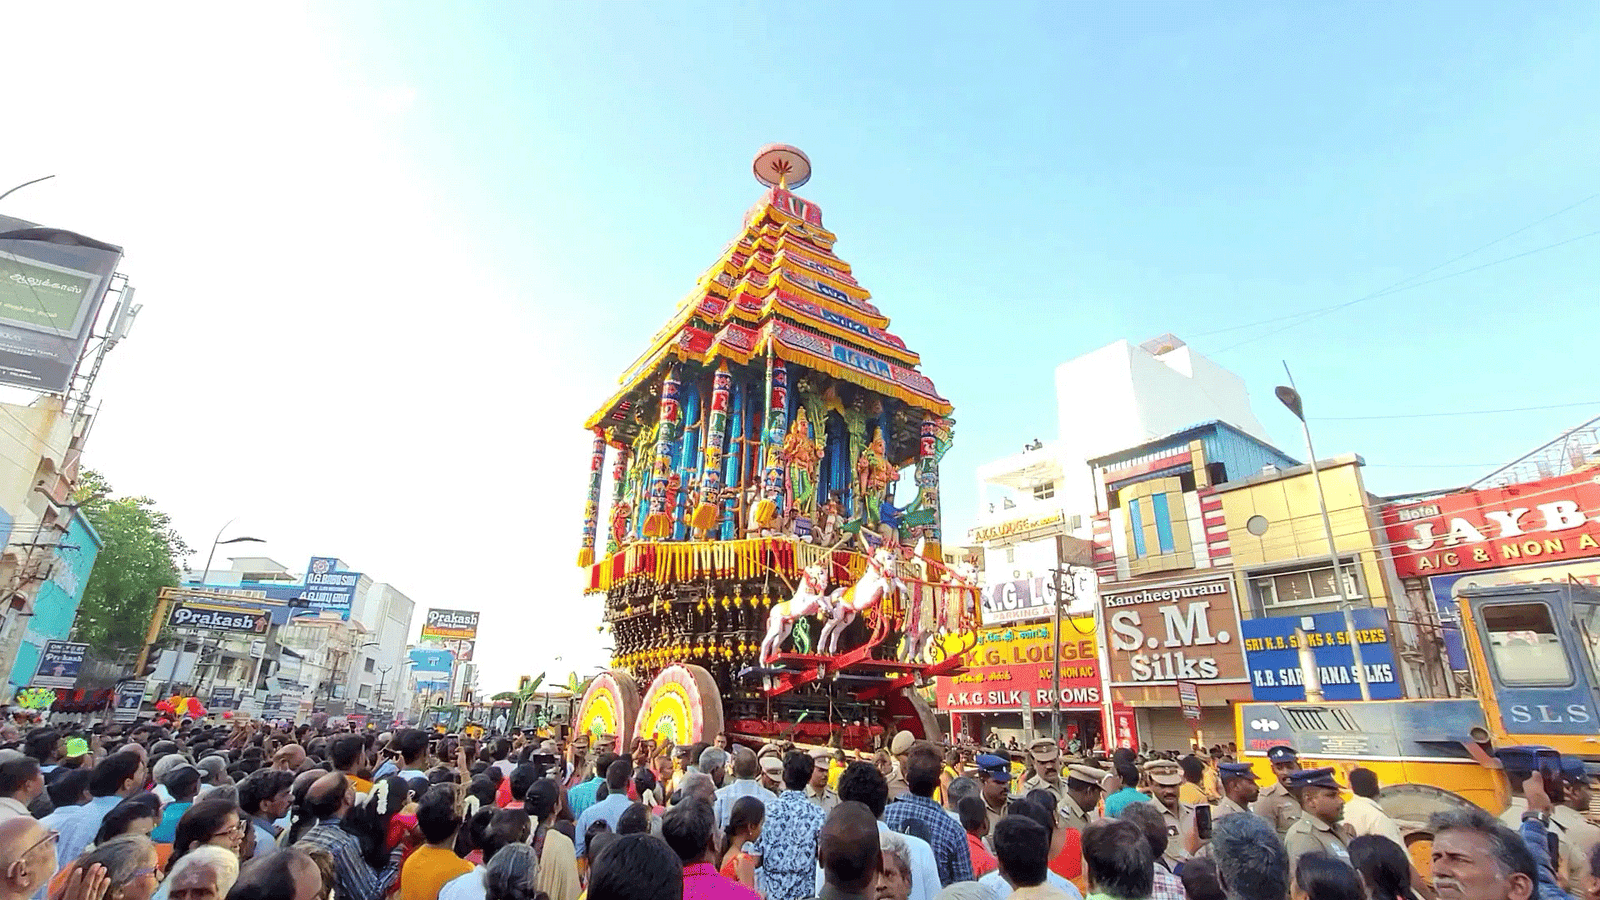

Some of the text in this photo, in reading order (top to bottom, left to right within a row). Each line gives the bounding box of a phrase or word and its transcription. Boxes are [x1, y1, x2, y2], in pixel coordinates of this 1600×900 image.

[1400, 504, 1439, 521] Hotel
[1407, 499, 1600, 550] JAYB
[1419, 552, 1460, 570] A/C
[1473, 547, 1491, 562] &
[1502, 539, 1564, 559] NON
[1104, 583, 1227, 608] Kancheepuram
[175, 608, 253, 629] Prakash
[428, 611, 478, 625] Prakash
[993, 608, 1039, 620] PARKING
[1111, 601, 1231, 652] S.M.
[1014, 640, 1094, 664] LODGE
[1245, 638, 1264, 651] SRI
[1326, 632, 1335, 645] &
[1130, 651, 1219, 681] Silks
[1254, 669, 1279, 687] K.B.
[1351, 664, 1394, 682] SLKS
[1511, 704, 1590, 723] SLS
